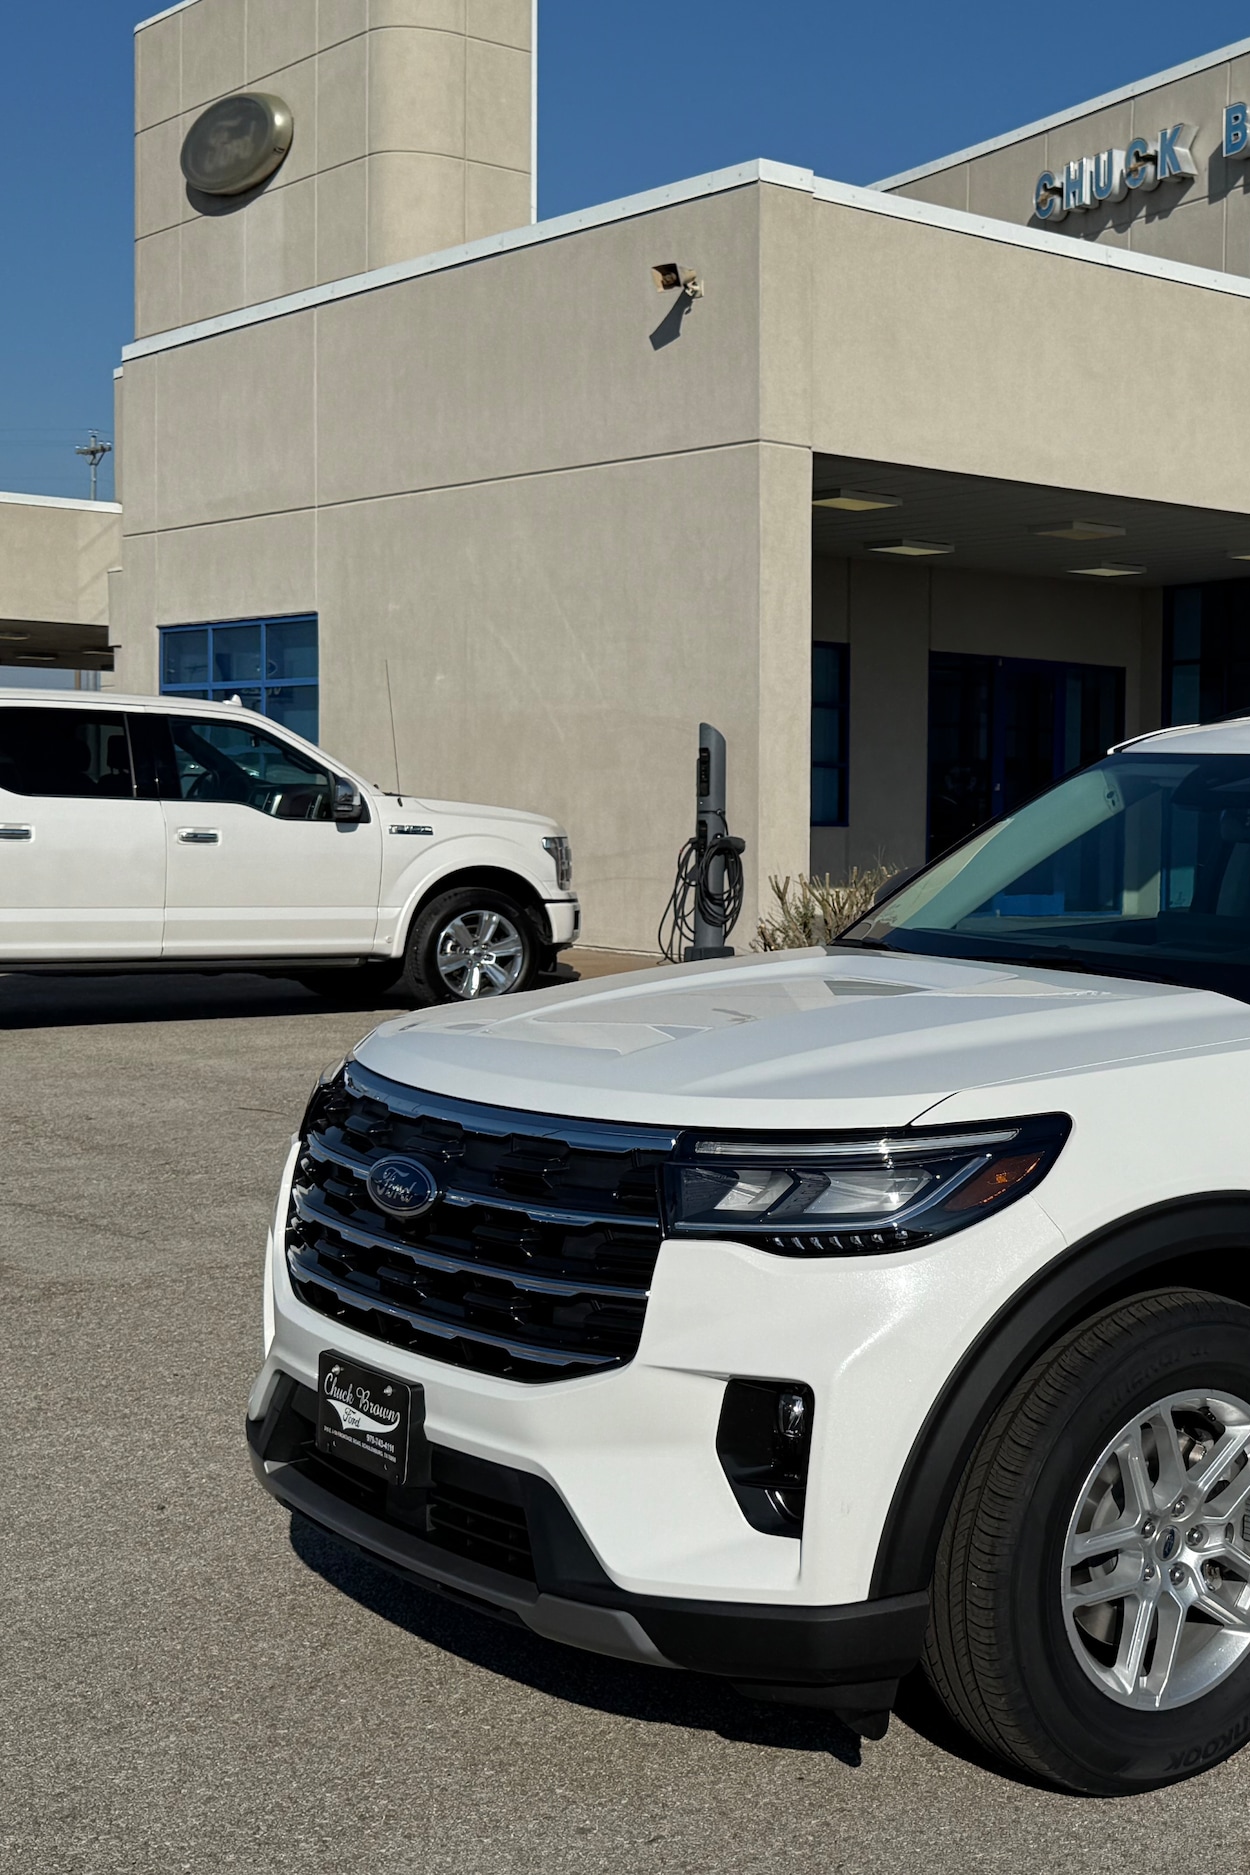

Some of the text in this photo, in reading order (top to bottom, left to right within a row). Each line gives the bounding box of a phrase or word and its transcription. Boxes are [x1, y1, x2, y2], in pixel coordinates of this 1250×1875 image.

[1033, 123, 1198, 222] CHUCK
[374, 1166, 418, 1203] Ford
[324, 1372, 400, 1424] Chuck Brown
[343, 1407, 361, 1428] Ford
